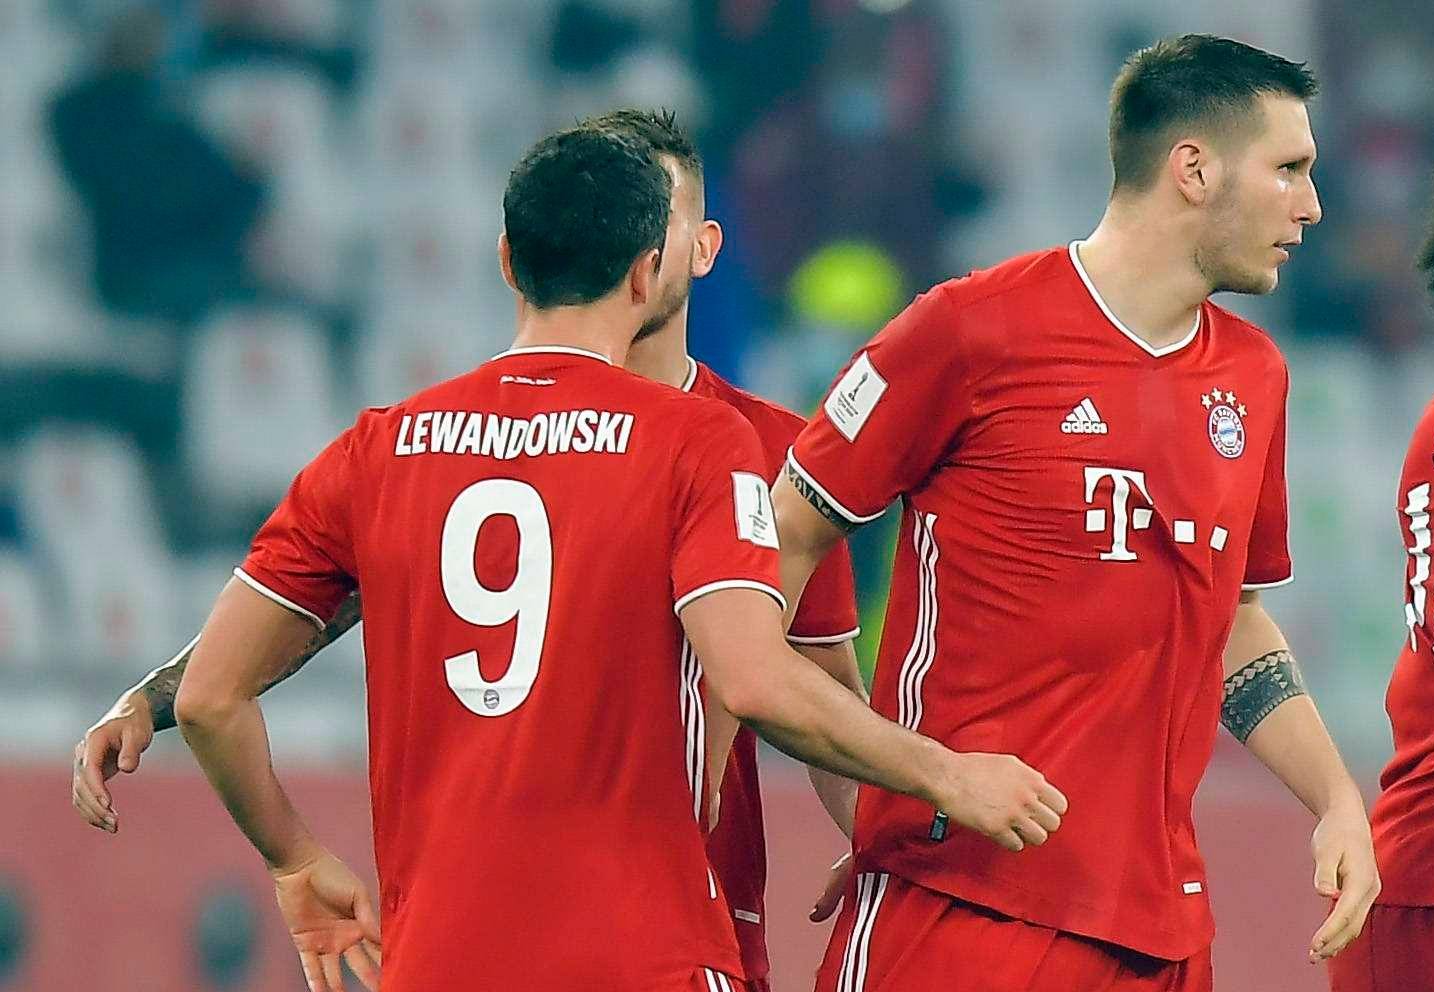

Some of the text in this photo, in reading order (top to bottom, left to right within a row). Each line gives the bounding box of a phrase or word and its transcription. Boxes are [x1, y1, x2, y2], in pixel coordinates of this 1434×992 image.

[395, 409, 635, 461] LEWANDOWSKI
[1060, 420, 1108, 434] adidas
[440, 478, 554, 718] 9
